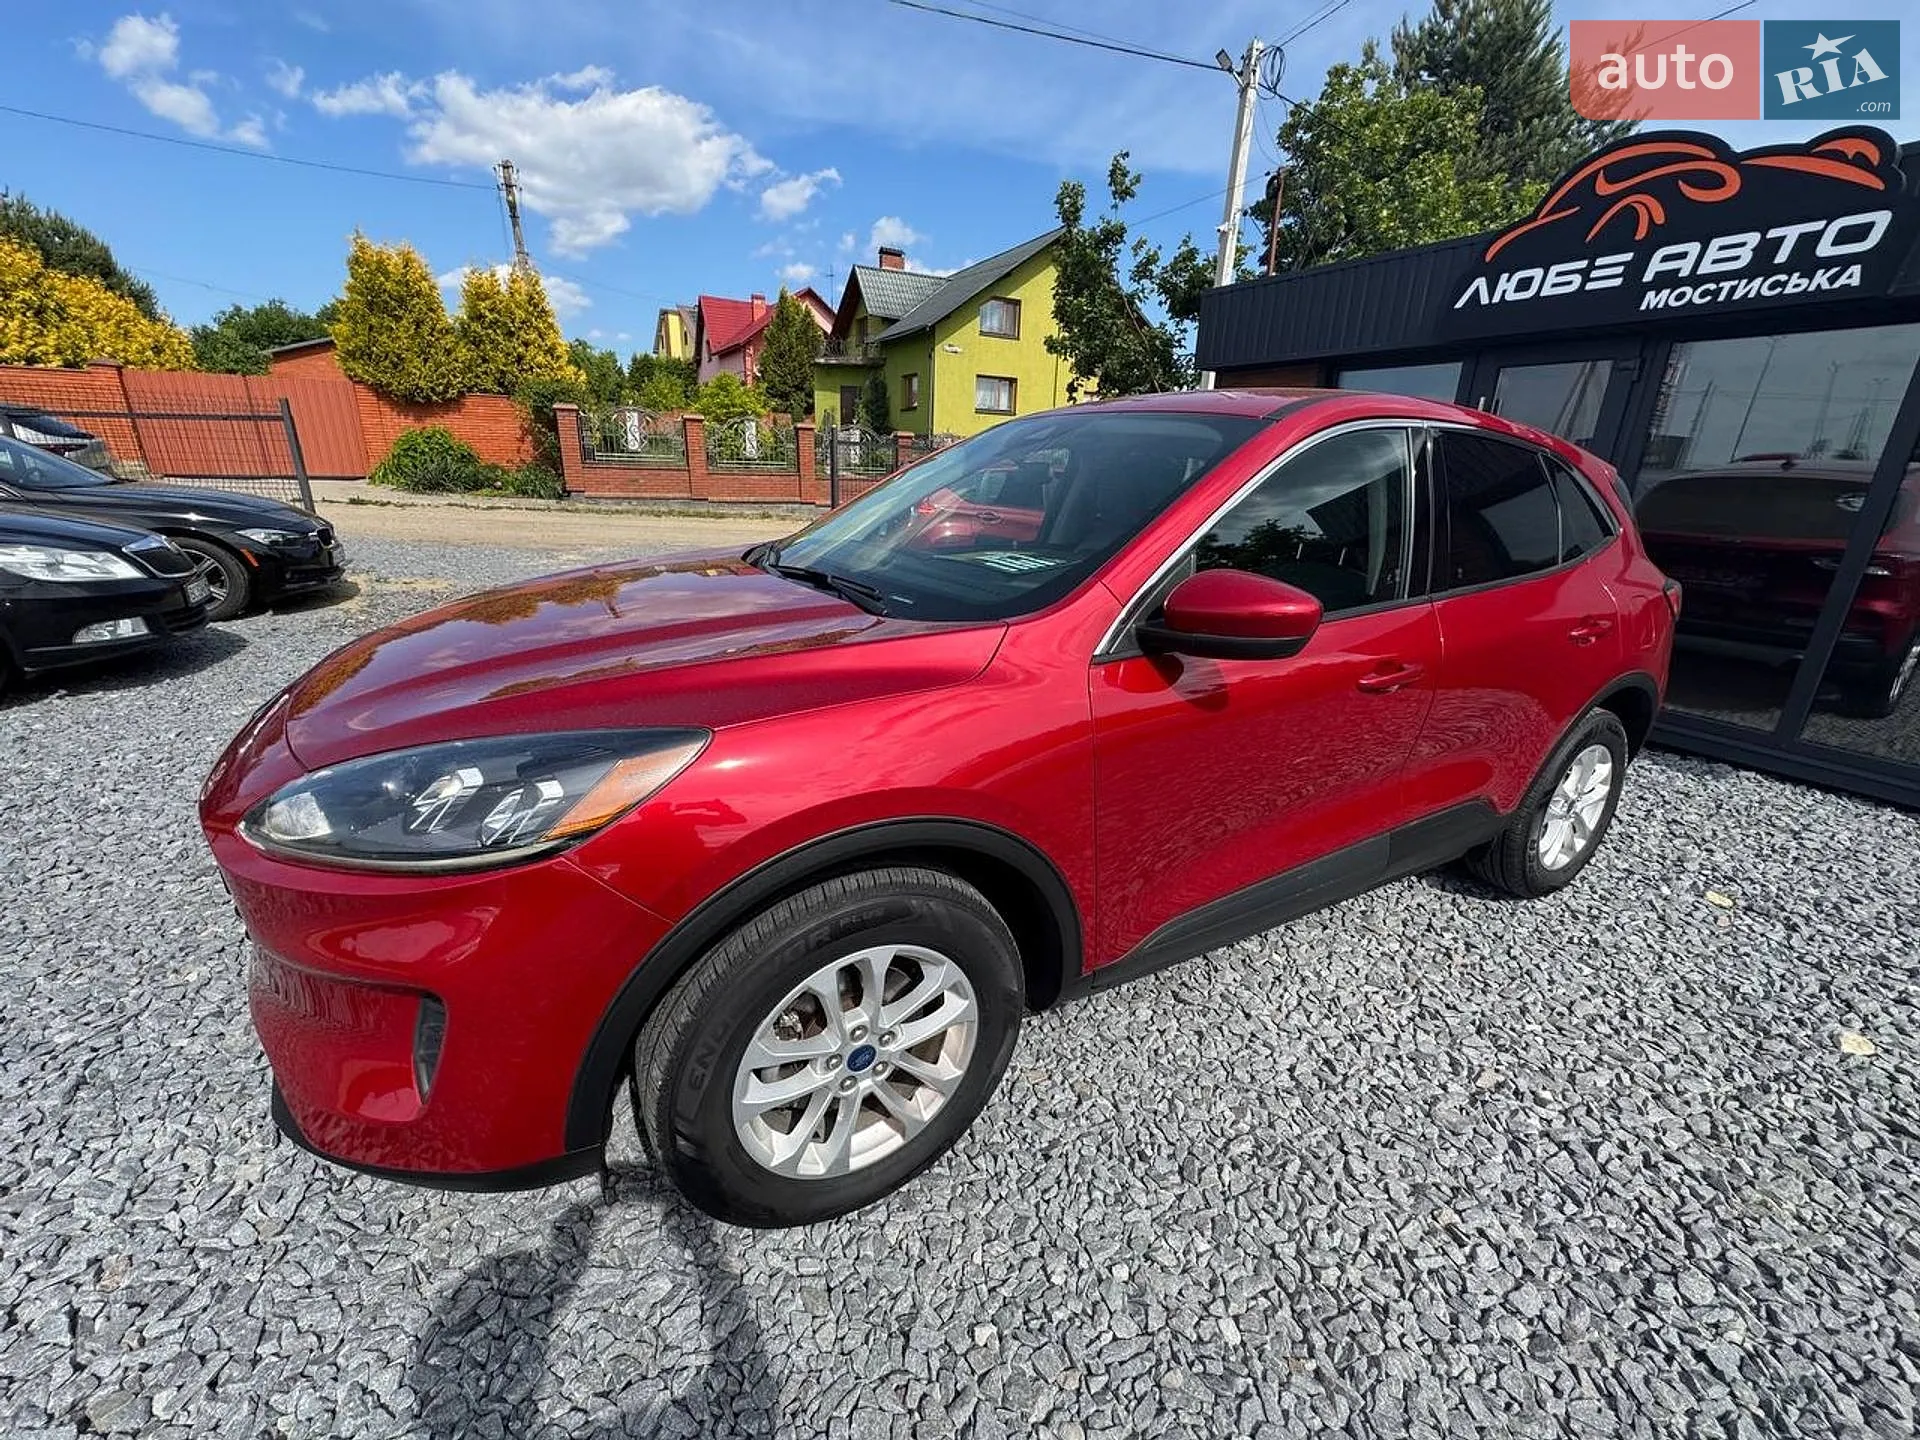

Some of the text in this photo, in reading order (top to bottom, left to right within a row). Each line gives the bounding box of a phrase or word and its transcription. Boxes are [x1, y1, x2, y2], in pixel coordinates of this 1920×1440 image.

[1453, 209, 1893, 309] ЛЮБЕ АВТО
[1639, 263, 1862, 311] МОСТИСЬКА
